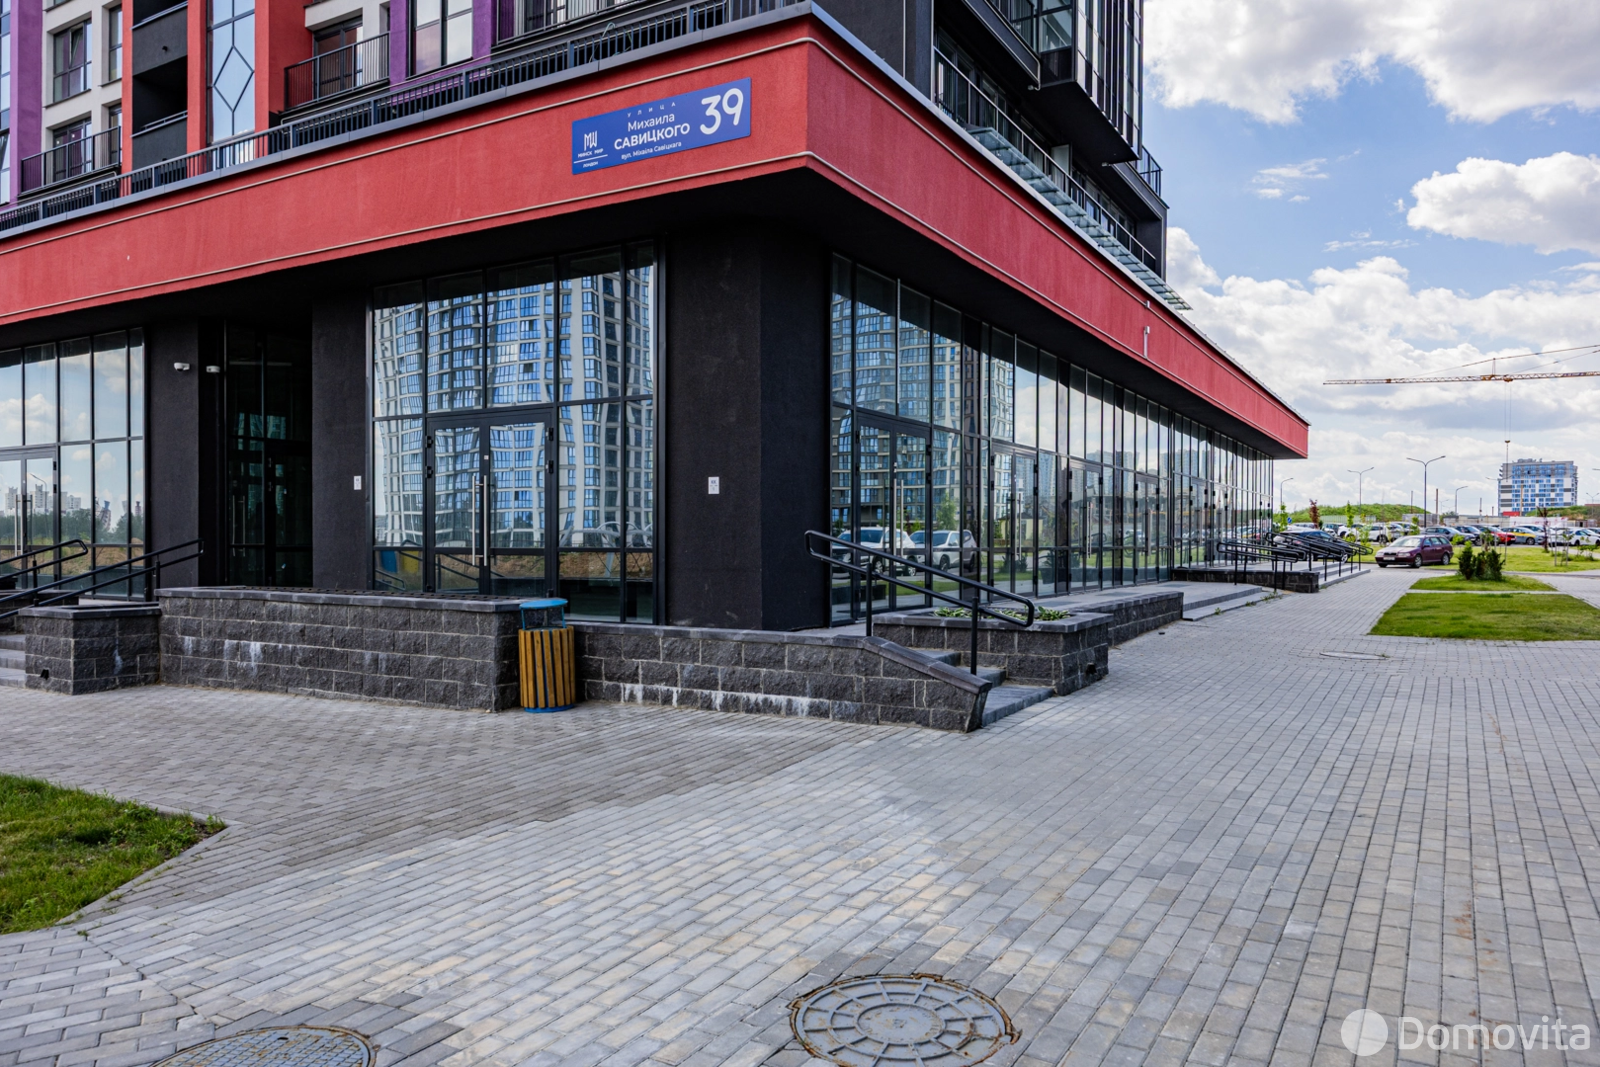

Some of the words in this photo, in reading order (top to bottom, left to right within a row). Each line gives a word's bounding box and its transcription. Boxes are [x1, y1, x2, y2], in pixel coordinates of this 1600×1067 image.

[627, 102, 676, 117] УЛИЦА
[700, 87, 744, 135] 39
[628, 113, 675, 132] Михаила
[614, 123, 690, 150] САВИЦКОГО
[654, 141, 682, 152] Савіцкага
